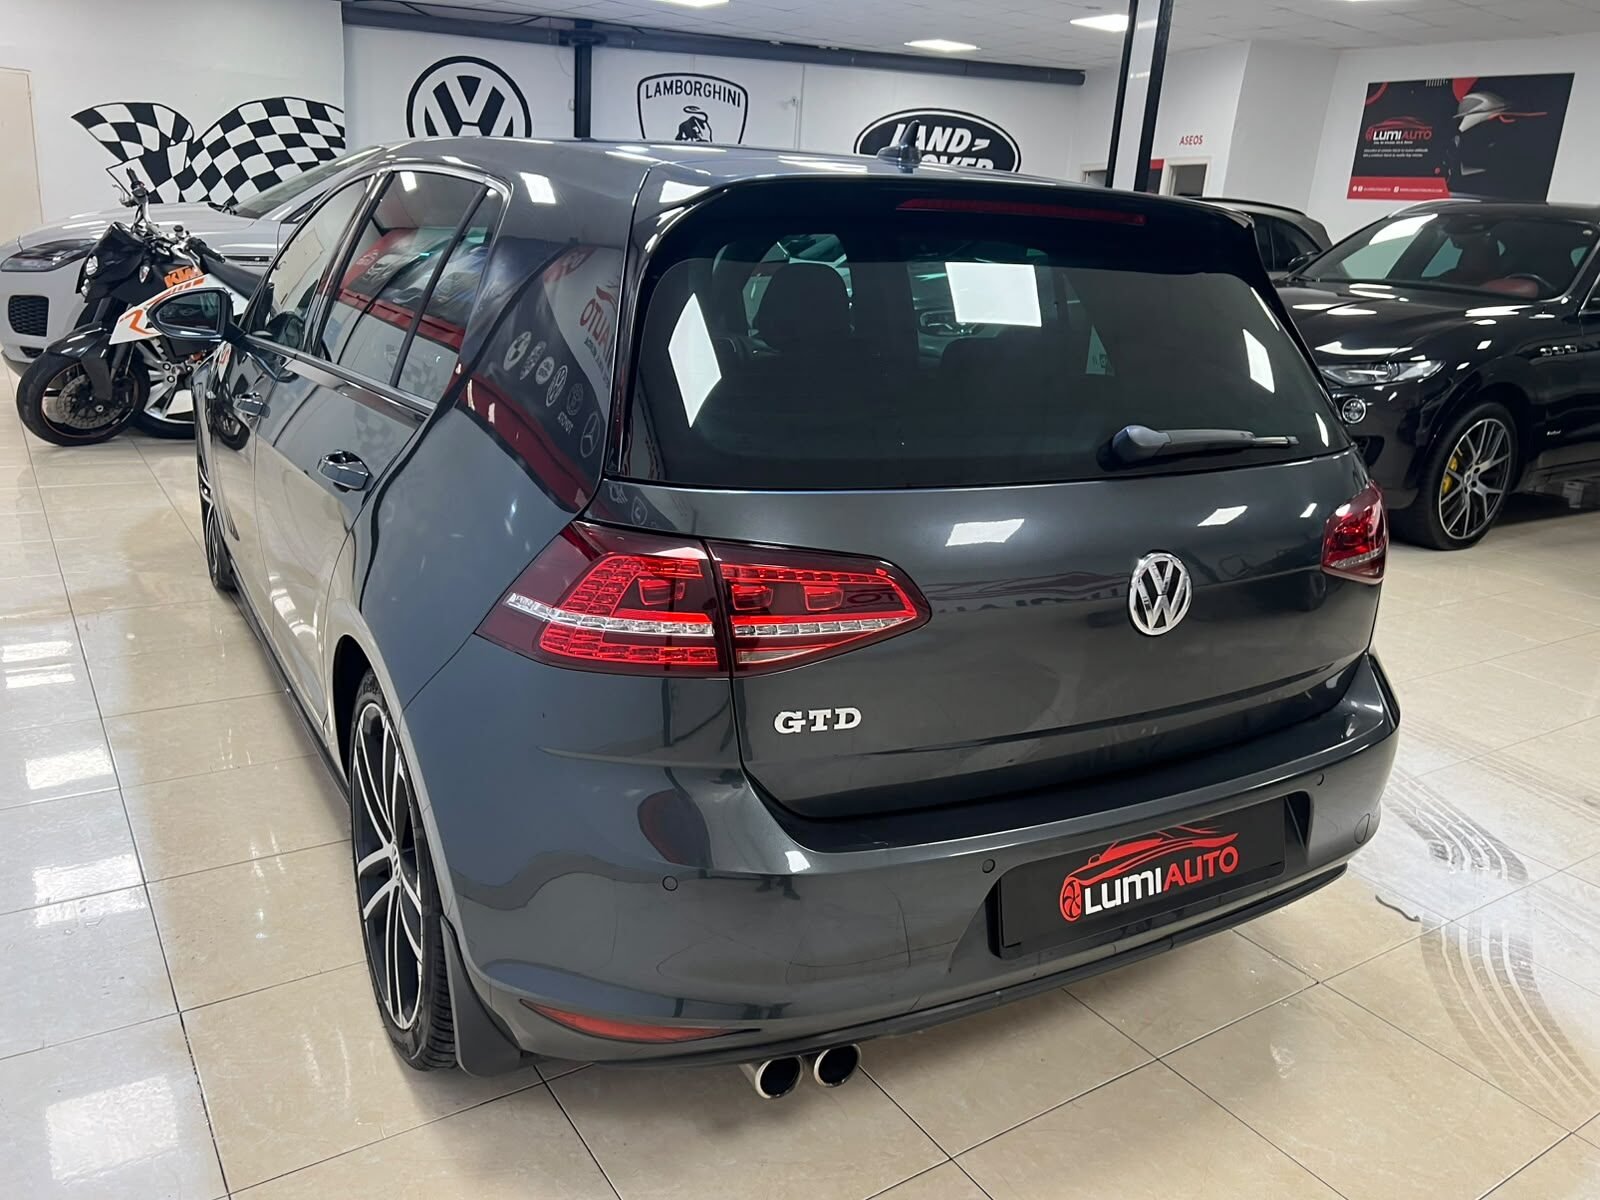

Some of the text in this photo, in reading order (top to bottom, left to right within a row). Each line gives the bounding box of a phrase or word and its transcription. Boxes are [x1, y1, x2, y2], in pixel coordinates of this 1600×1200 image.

[645, 80, 741, 108] LAMBORGHINI
[1179, 135, 1203, 145] ASEOS
[774, 707, 862, 734] GTD
